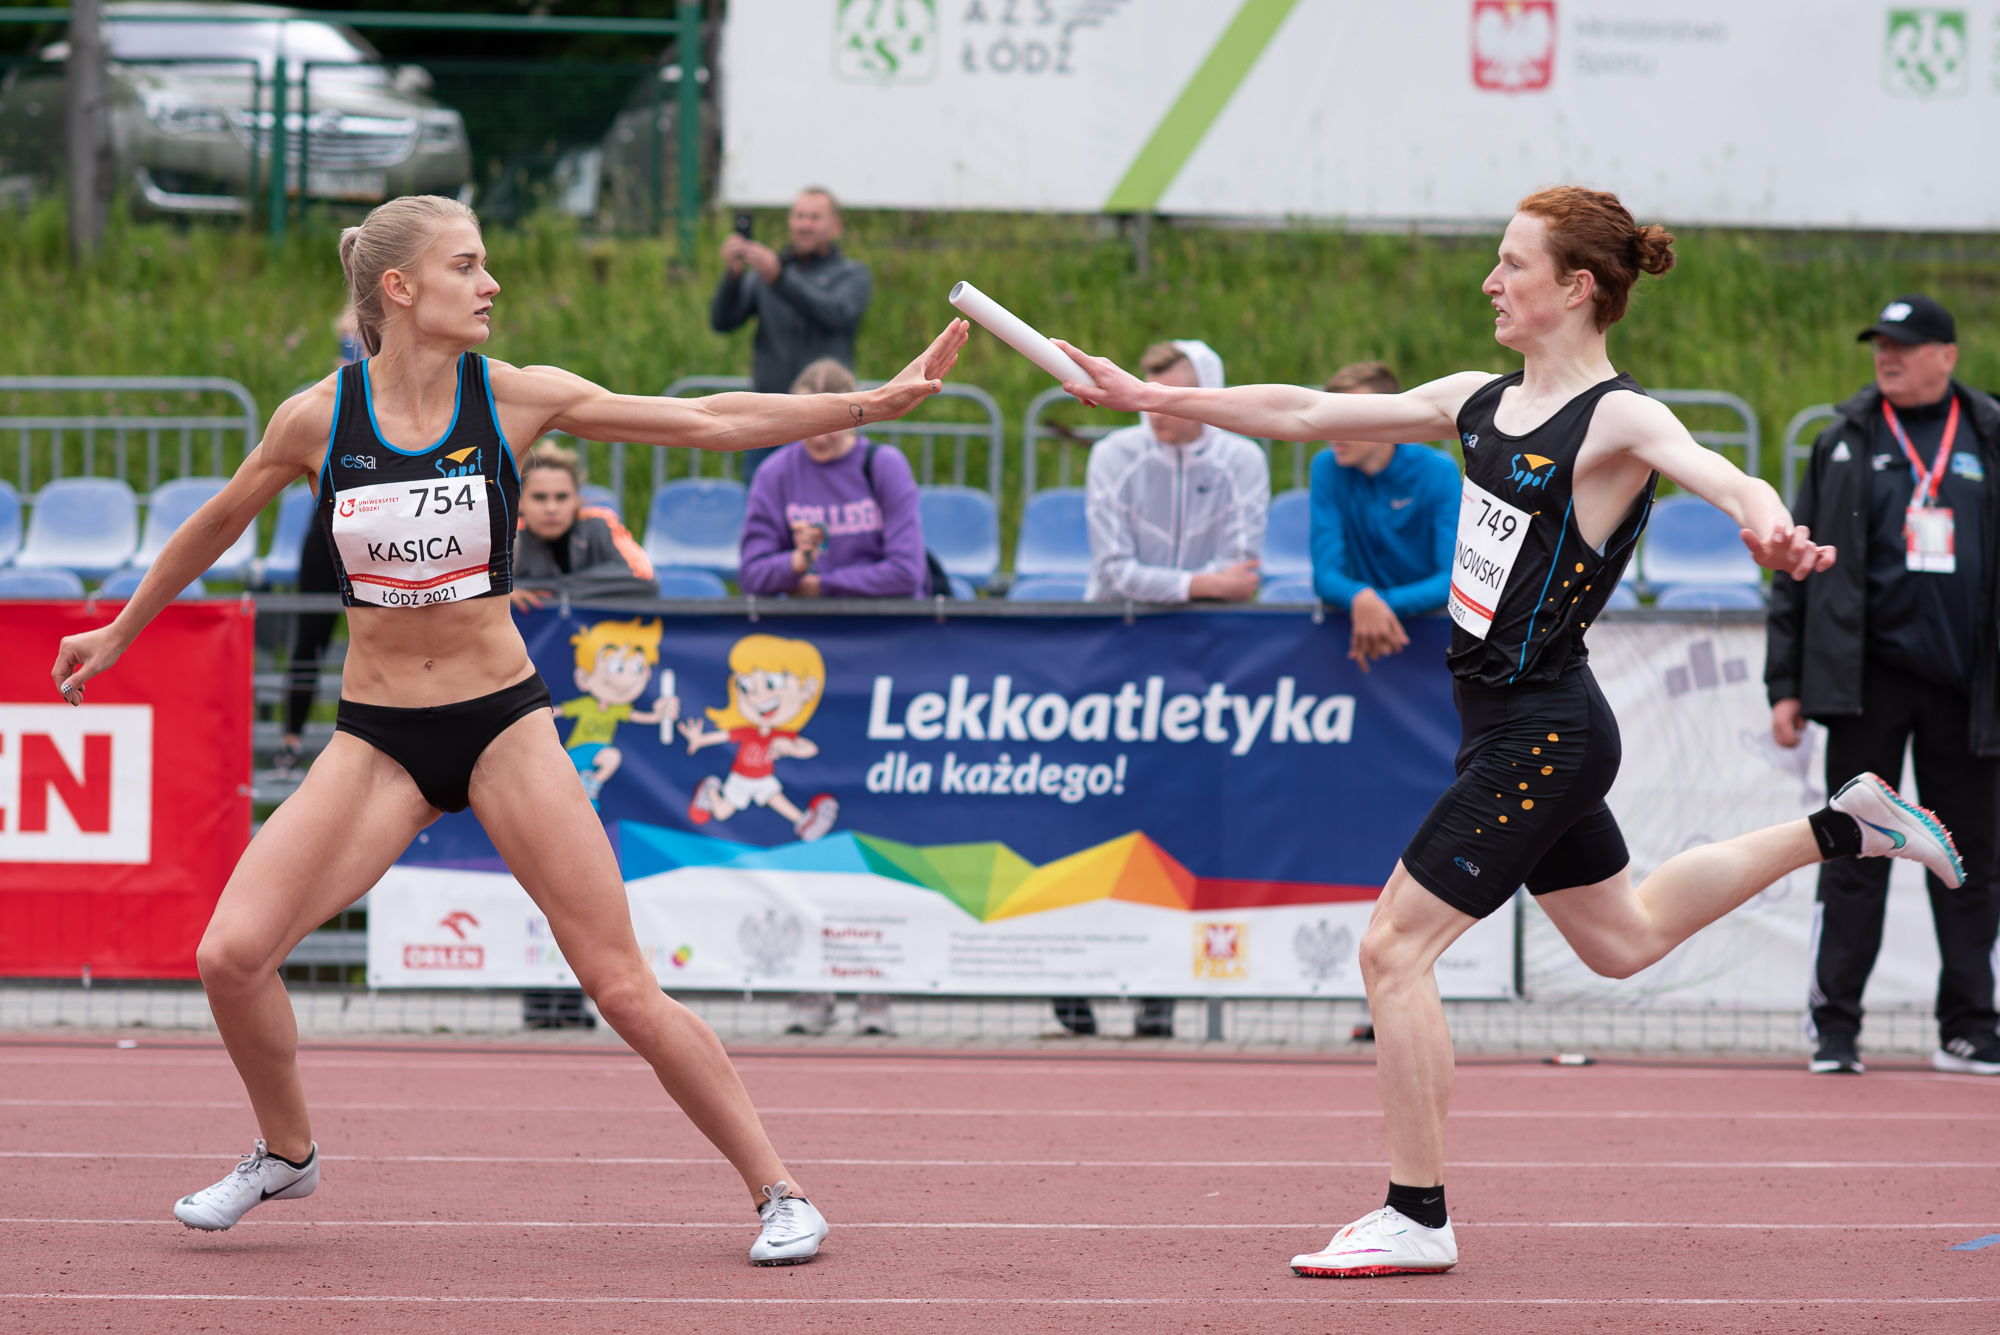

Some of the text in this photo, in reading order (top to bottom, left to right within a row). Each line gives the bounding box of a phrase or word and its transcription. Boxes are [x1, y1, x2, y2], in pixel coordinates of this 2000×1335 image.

[1504, 453, 1557, 493] Sopot
[358, 497, 399, 506] UNIWERSYTET
[409, 484, 476, 518] 754
[1477, 498, 1517, 542] 749
[367, 535, 463, 563] KASICA
[382, 586, 457, 606] ŁÓDŹ 2021
[867, 675, 1356, 756] Lekkoatletyka
[866, 751, 1128, 803] dla każdego!
